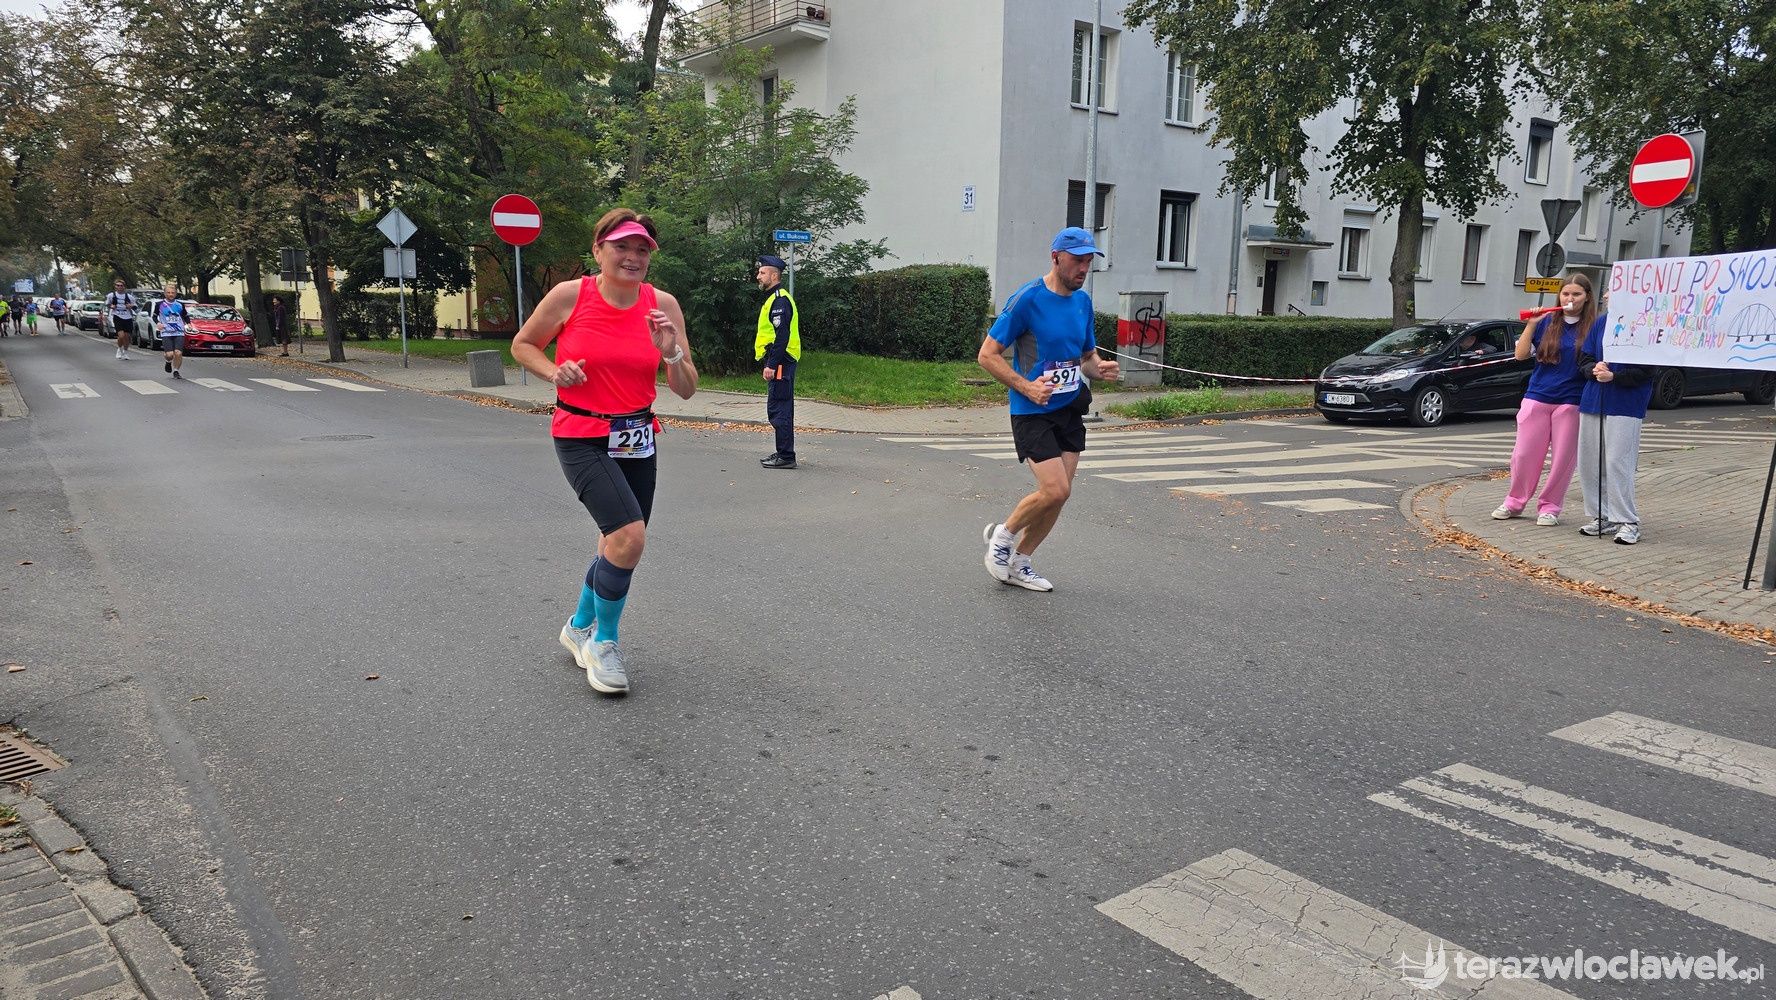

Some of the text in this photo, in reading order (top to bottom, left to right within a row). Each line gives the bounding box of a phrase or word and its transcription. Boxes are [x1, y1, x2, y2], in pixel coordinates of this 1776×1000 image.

[964, 192, 973, 205] 31
[1529, 279, 1560, 287] Objazd
[1612, 254, 1776, 294] BIEGNIJ PO SWOJ
[1645, 295, 1669, 314] DLA
[1648, 327, 1665, 346] WE
[1051, 368, 1077, 384] 697
[618, 427, 649, 448] 229
